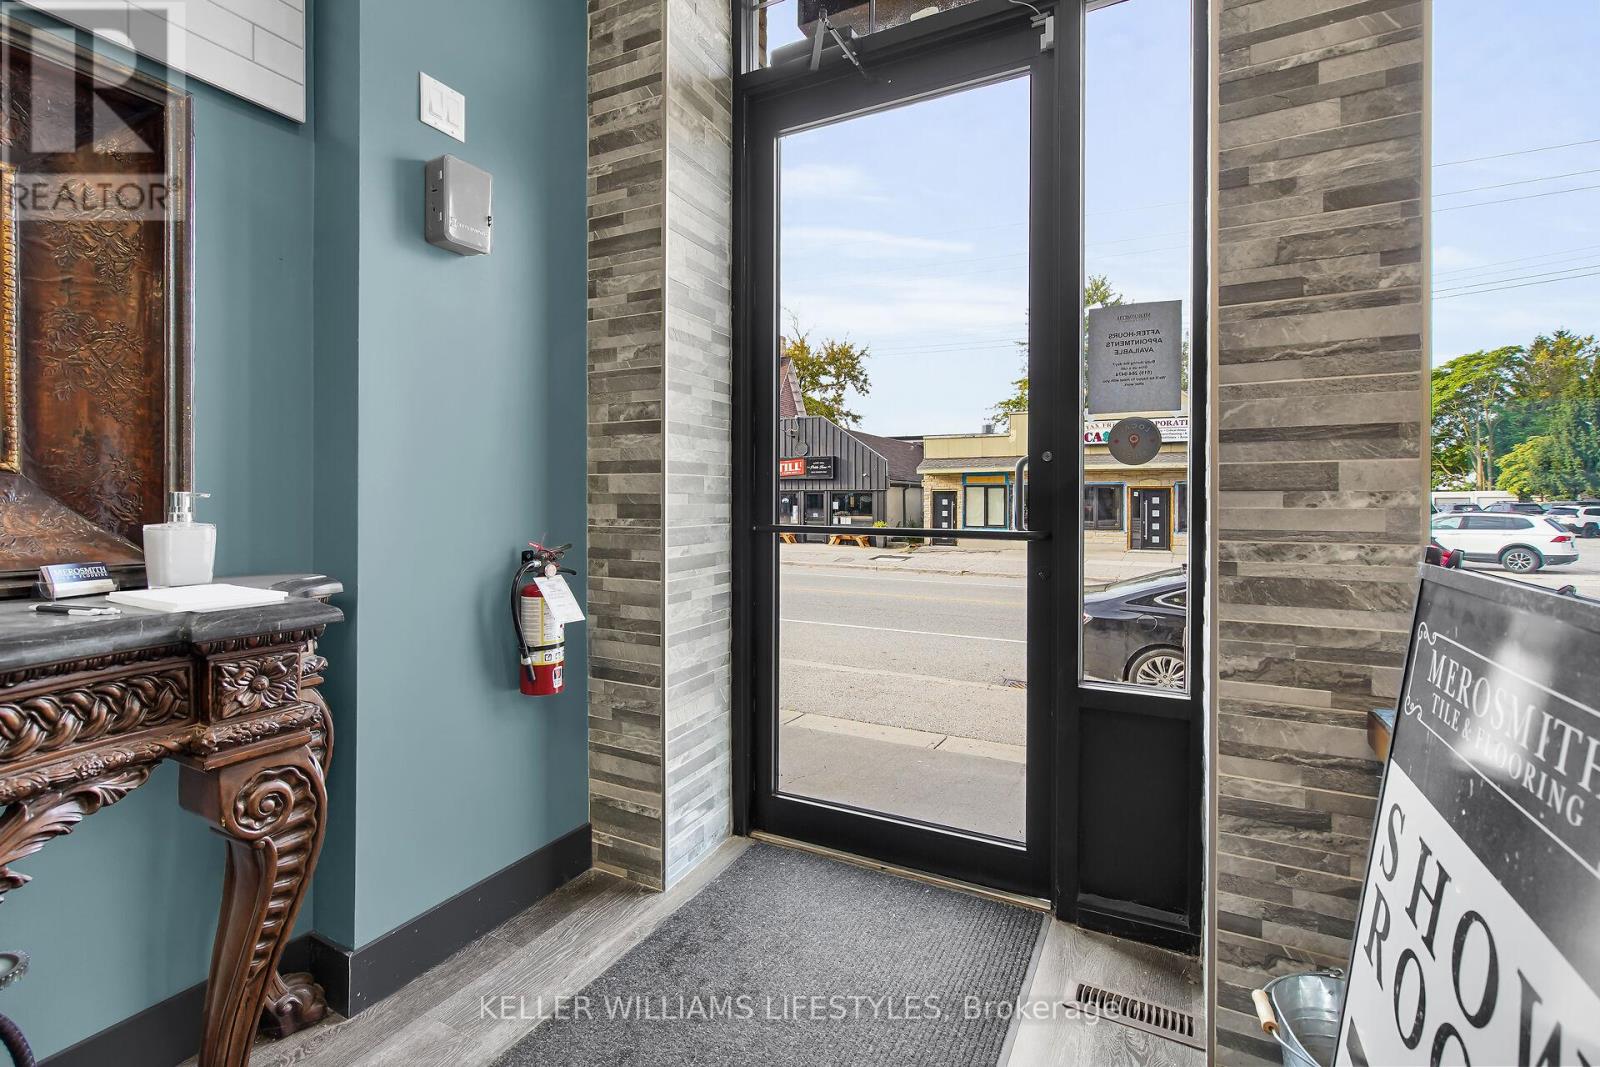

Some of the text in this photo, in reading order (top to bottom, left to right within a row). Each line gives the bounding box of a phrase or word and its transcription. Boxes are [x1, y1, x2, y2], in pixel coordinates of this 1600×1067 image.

[1431, 692, 1585, 827] TILE & FLOORING
